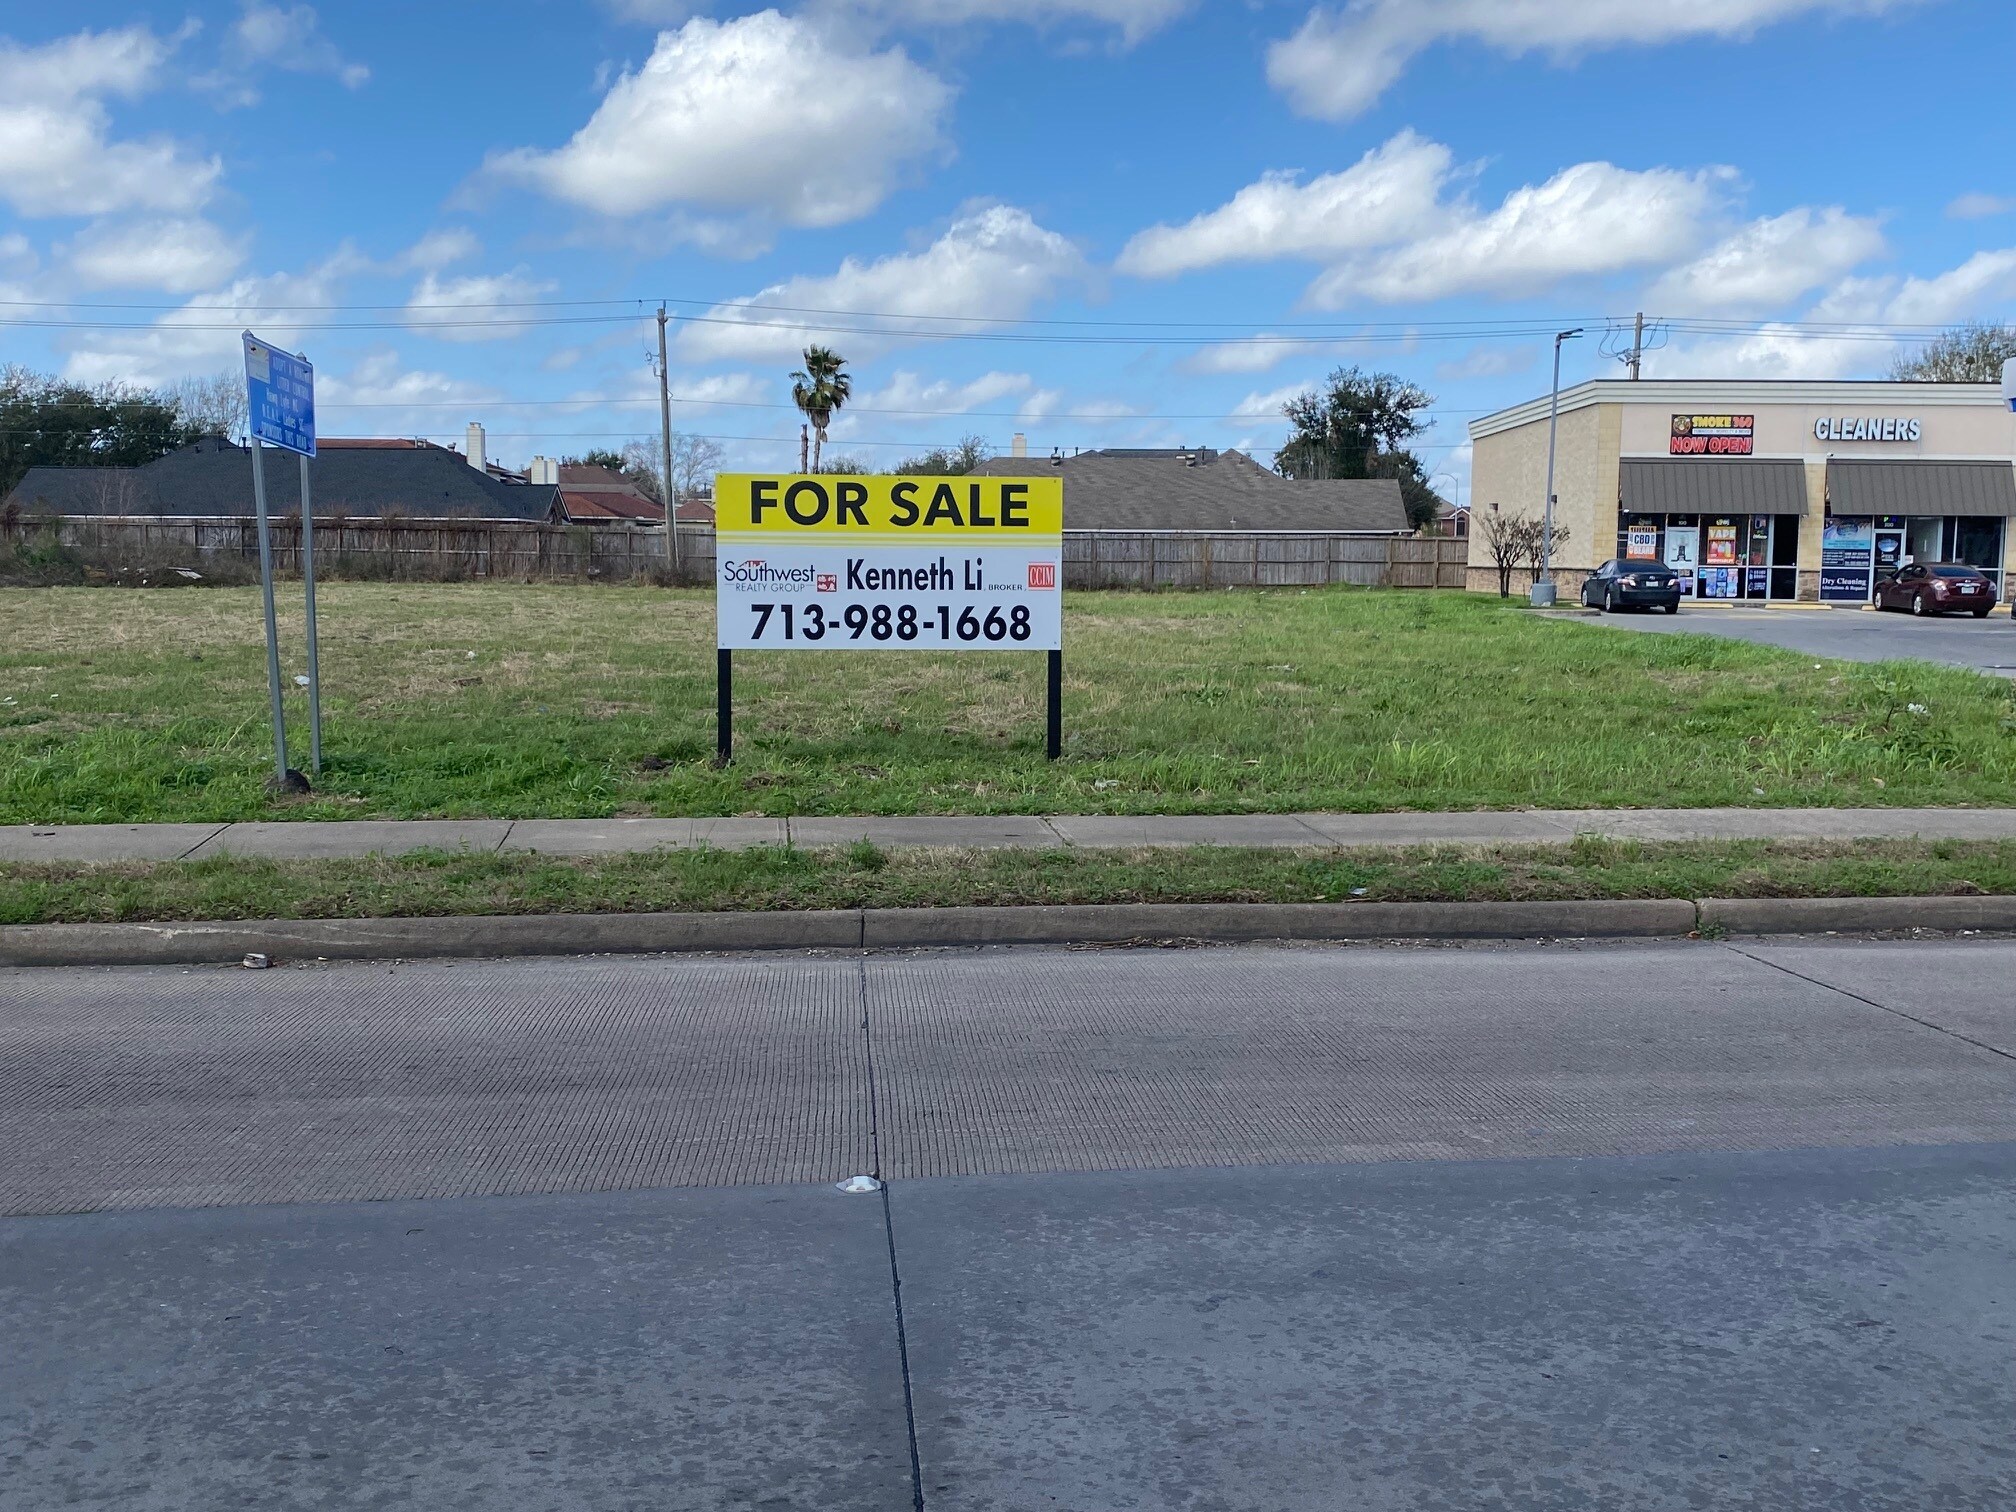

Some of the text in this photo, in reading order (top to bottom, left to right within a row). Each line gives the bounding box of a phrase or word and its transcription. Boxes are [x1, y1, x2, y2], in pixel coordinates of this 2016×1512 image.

[1692, 416, 1732, 428] SMOKE
[1813, 417, 1921, 442] CLEANERS
[1671, 436, 1752, 454] NOW OPEN!
[750, 480, 1030, 527] FOR SALE
[1634, 534, 1650, 545] CBD
[1709, 529, 1736, 538] VAPE
[724, 560, 816, 582] Southwest
[847, 556, 954, 591] Kenneth
[1029, 566, 1053, 586] CCIM
[735, 583, 768, 592] REALTY
[770, 583, 806, 593] GROUP
[1822, 577, 1867, 586] Dry Cleaning
[750, 603, 1031, 641] 713-988-1668
